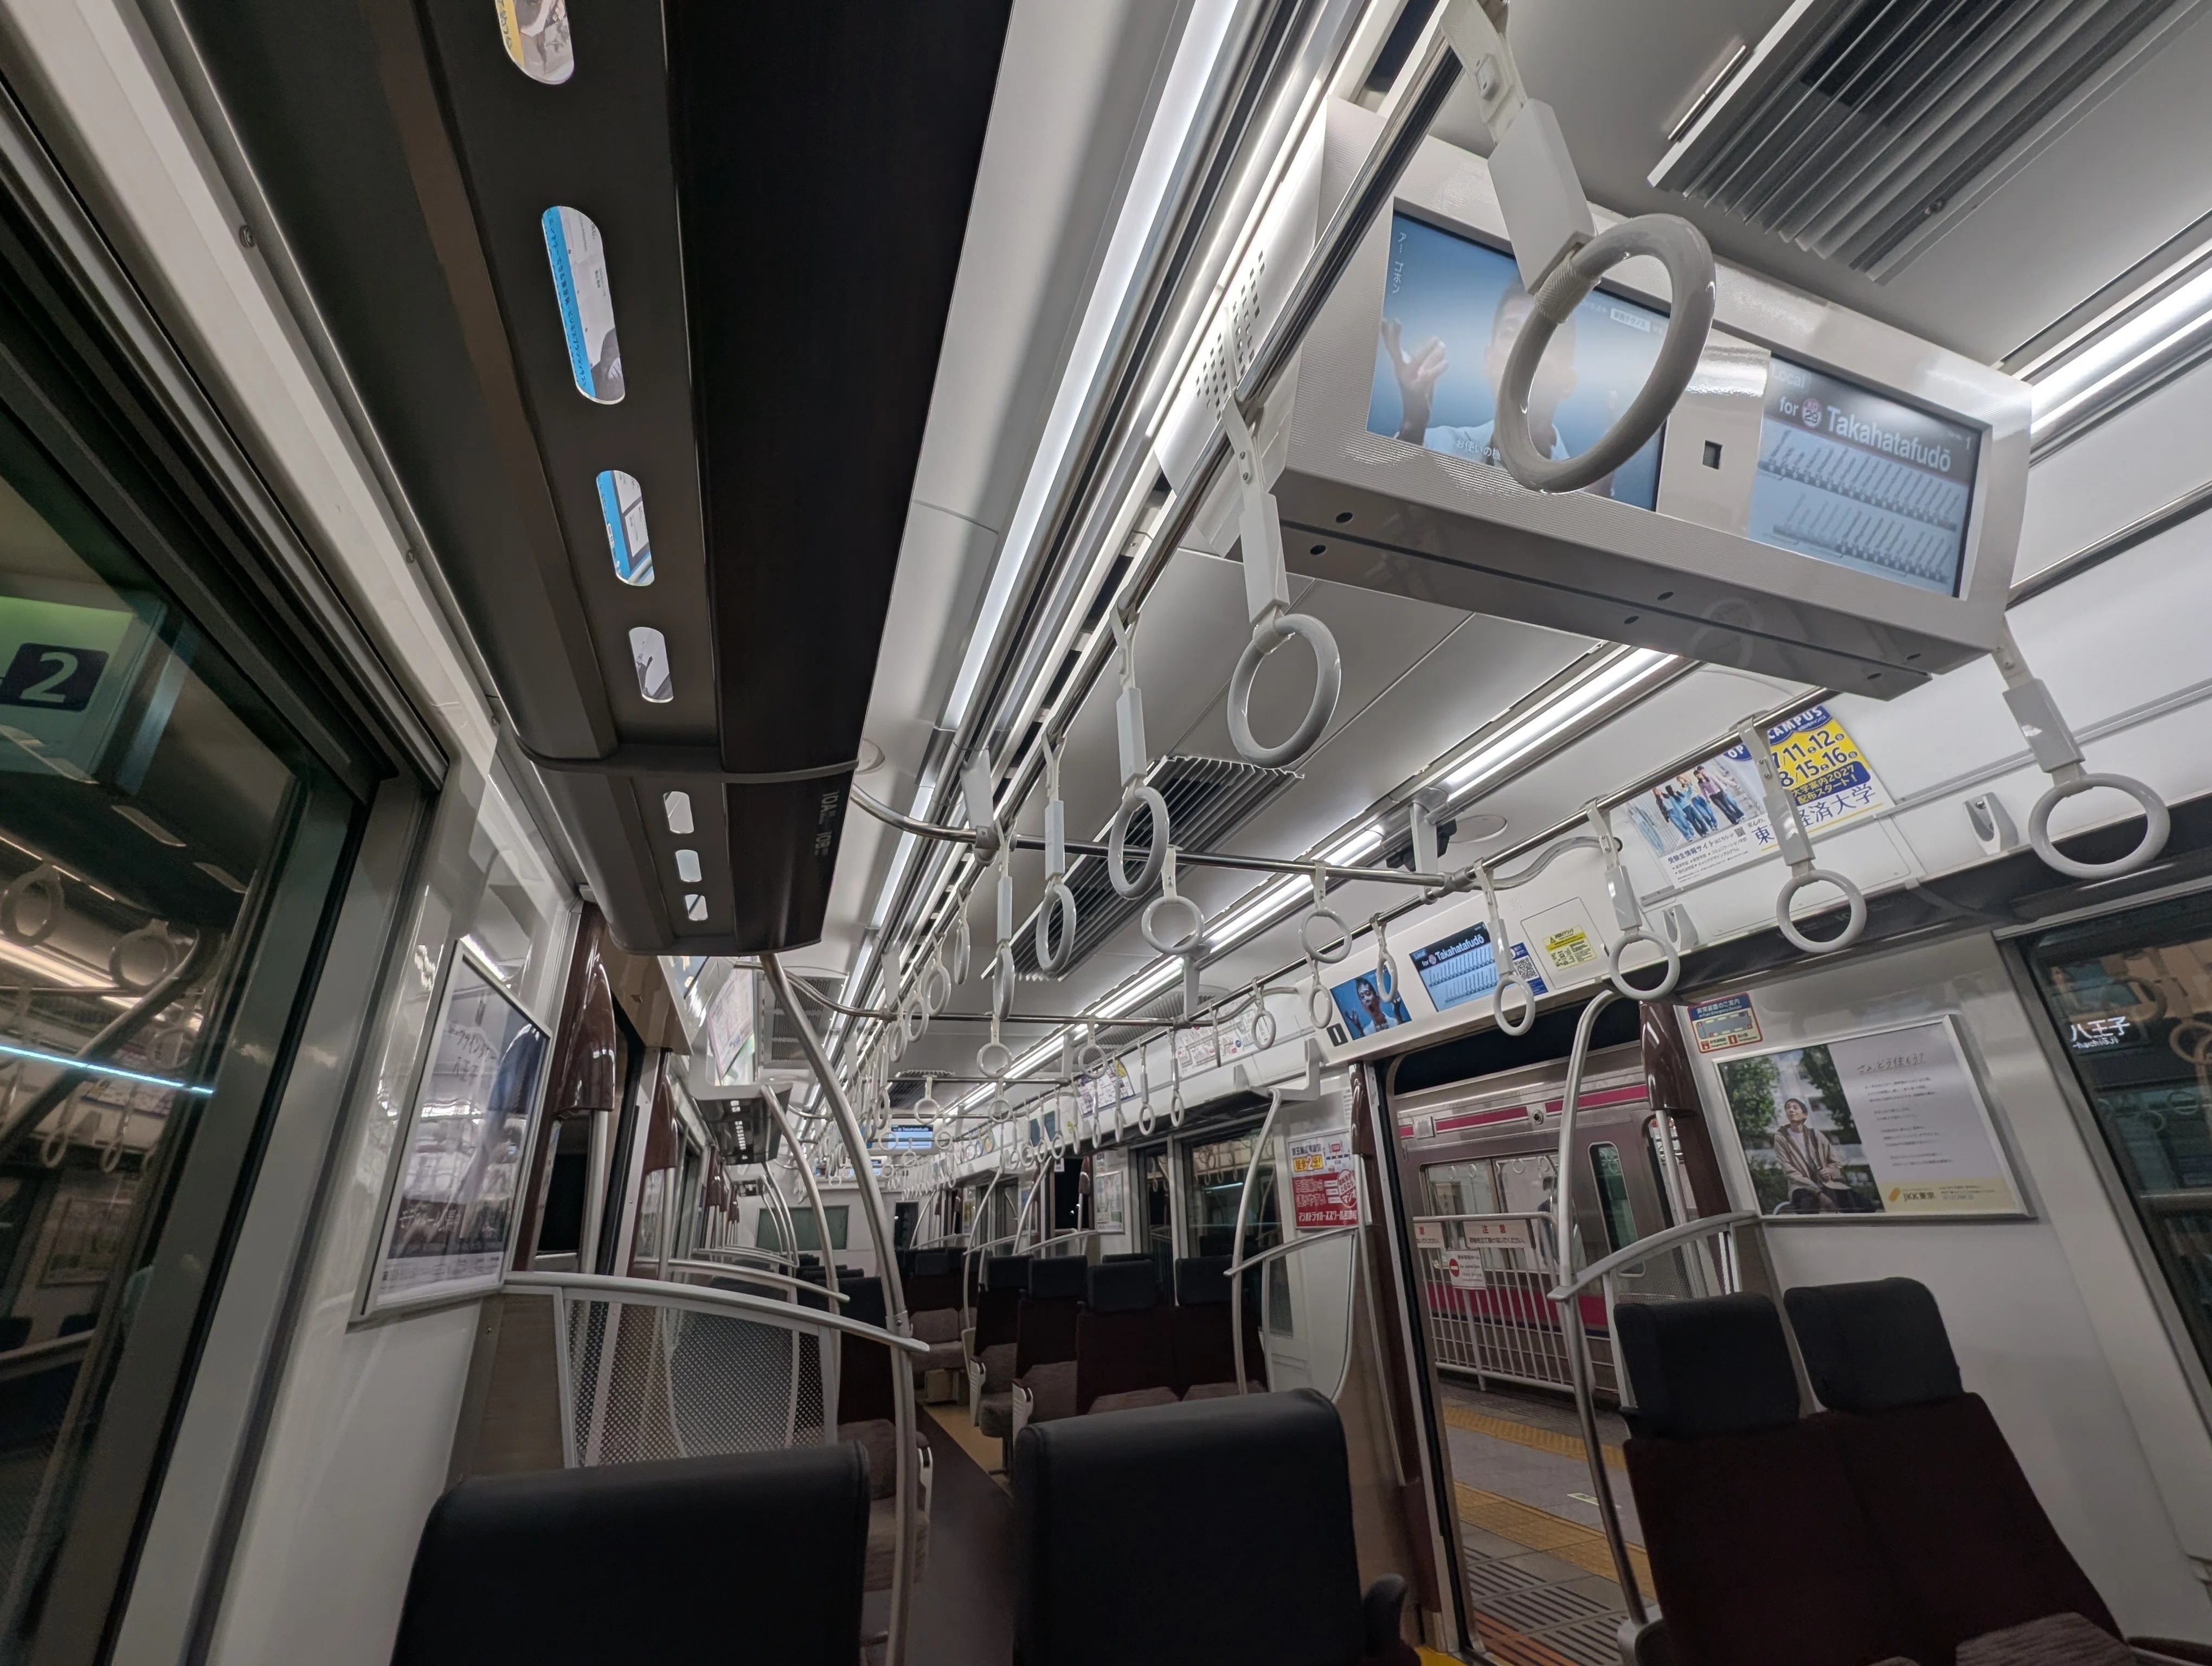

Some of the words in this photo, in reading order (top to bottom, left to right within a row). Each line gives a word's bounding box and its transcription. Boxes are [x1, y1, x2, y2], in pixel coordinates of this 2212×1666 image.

[1771, 363, 1805, 389] Local
[1779, 396, 1799, 416] for
[1805, 409, 1819, 425] 29
[1826, 405, 1951, 473] Takahatafudō
[20, 651, 78, 703] 2
[1767, 708, 1823, 739] CAMPUS
[1435, 933, 1484, 962] Takahatafudō
[2070, 1016, 2131, 1042] 八王子
